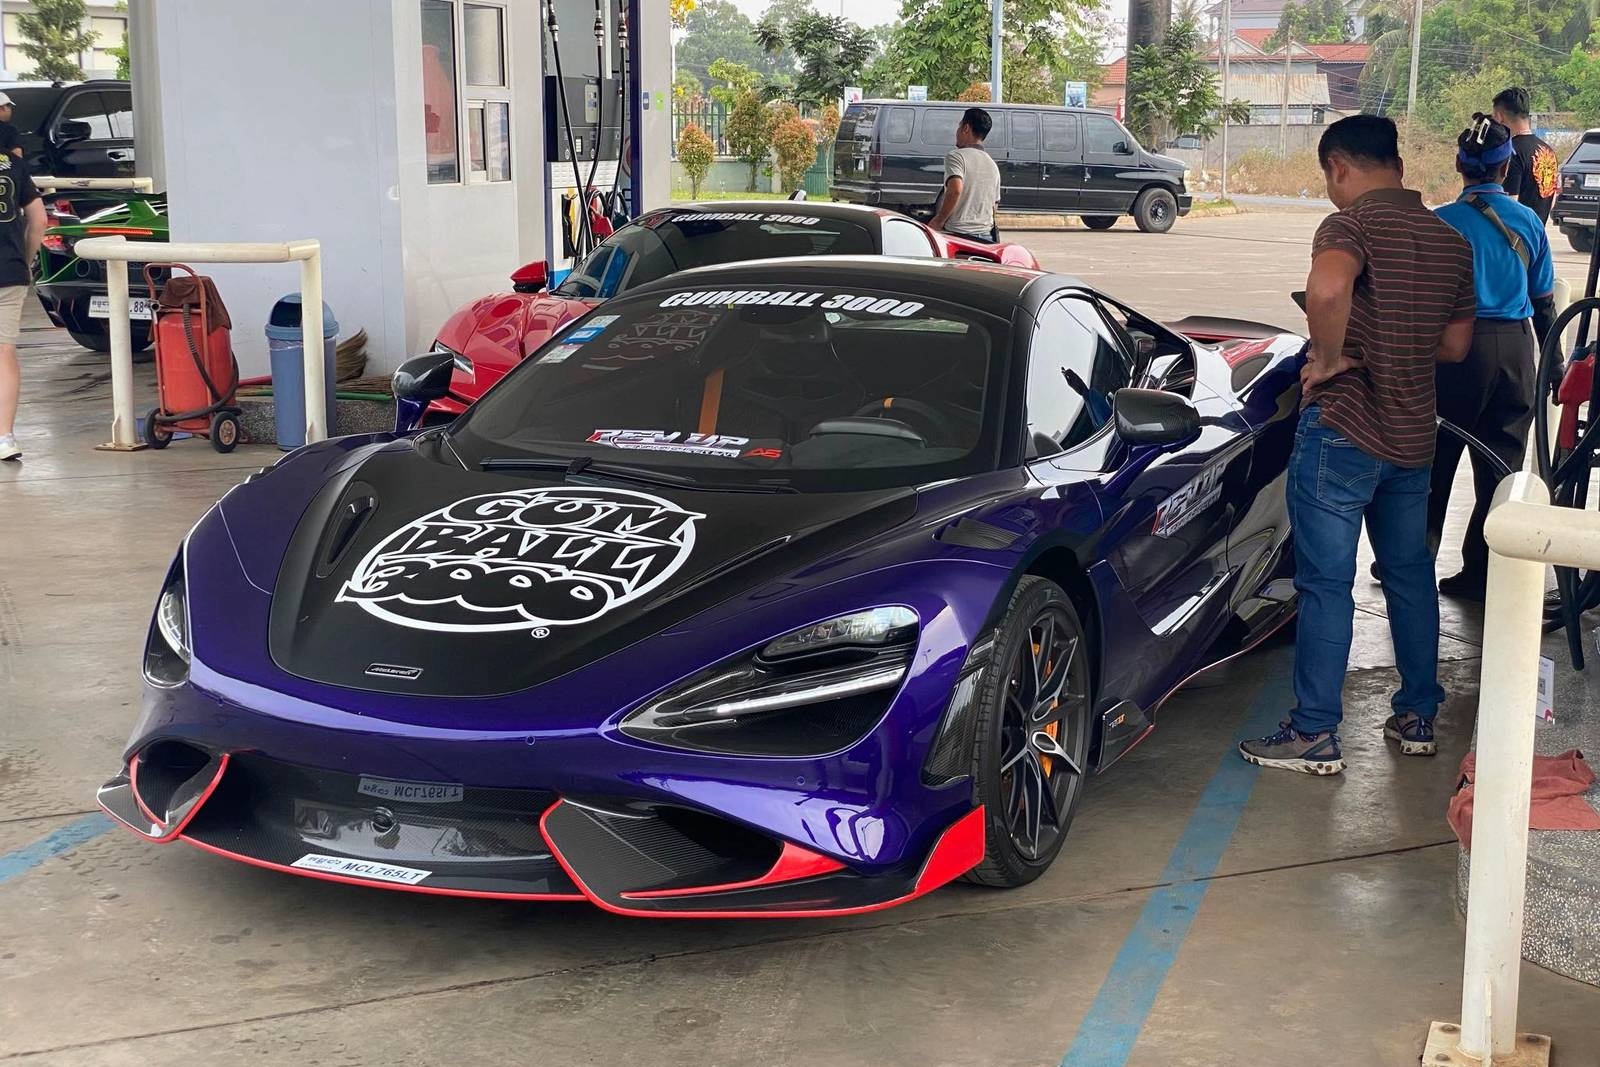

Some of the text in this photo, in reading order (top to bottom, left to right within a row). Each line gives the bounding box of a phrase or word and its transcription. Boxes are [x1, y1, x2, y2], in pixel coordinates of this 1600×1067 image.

[671, 212, 821, 225] GUMBALL 3000
[659, 290, 925, 317] GUMBALL 3000
[585, 429, 750, 451] REV UP
[341, 862, 423, 880] MCL765LT
